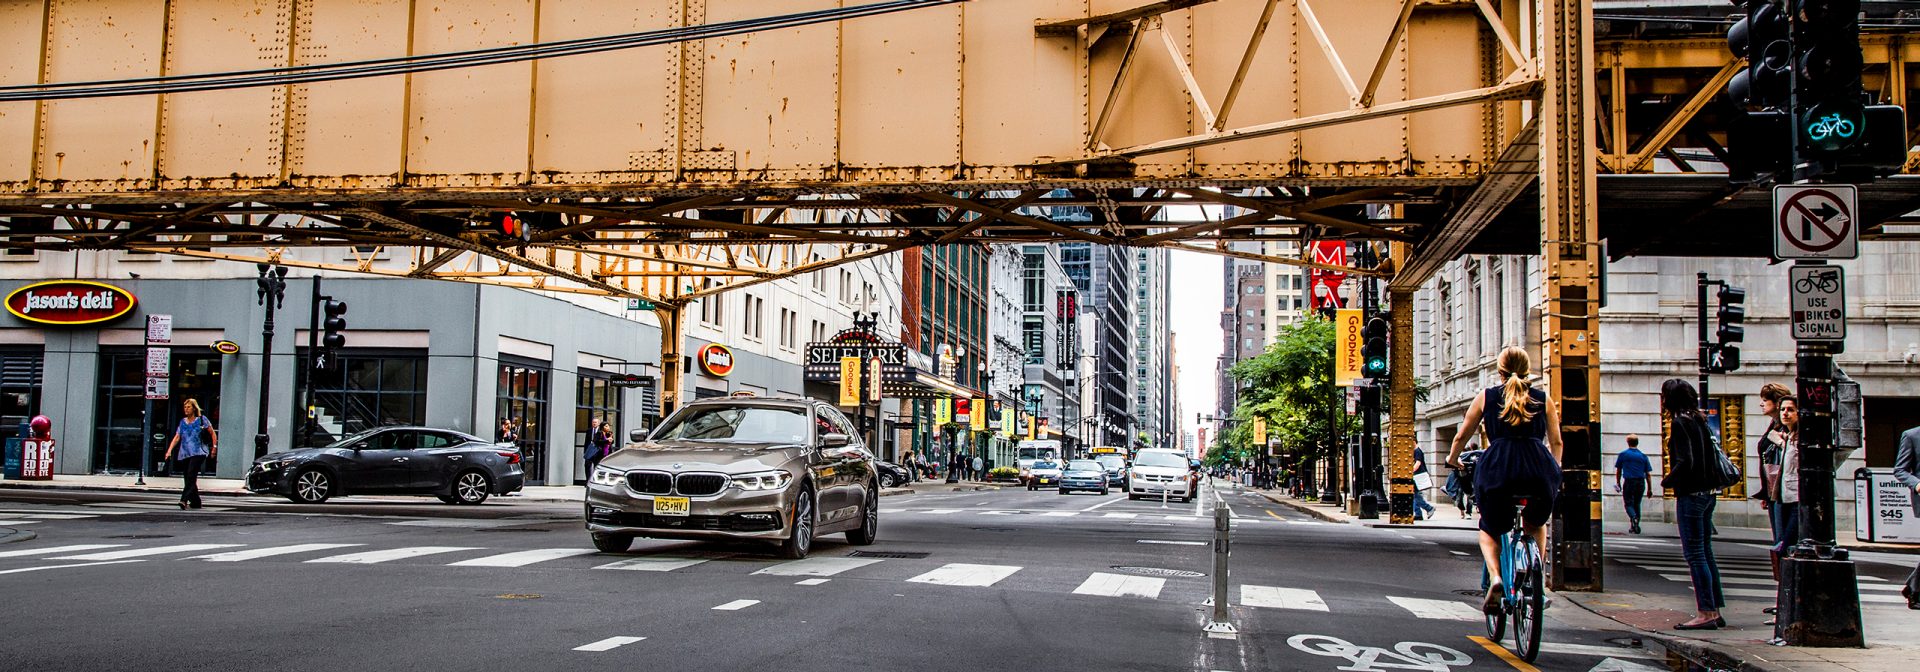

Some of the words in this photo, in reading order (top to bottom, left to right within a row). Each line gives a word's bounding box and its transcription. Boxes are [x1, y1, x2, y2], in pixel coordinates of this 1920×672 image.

[23, 291, 79, 314] Jason's
[80, 291, 113, 309] deli
[1067, 296, 1075, 319] amc
[1807, 297, 1828, 308] USE
[1806, 310, 1830, 321] BIKE
[1799, 323, 1839, 334] SIGNAL
[1348, 315, 1360, 372] GOODMAN
[847, 361, 855, 397] GOODMAN
[656, 501, 670, 512] U25
[1881, 509, 1903, 519] $45
